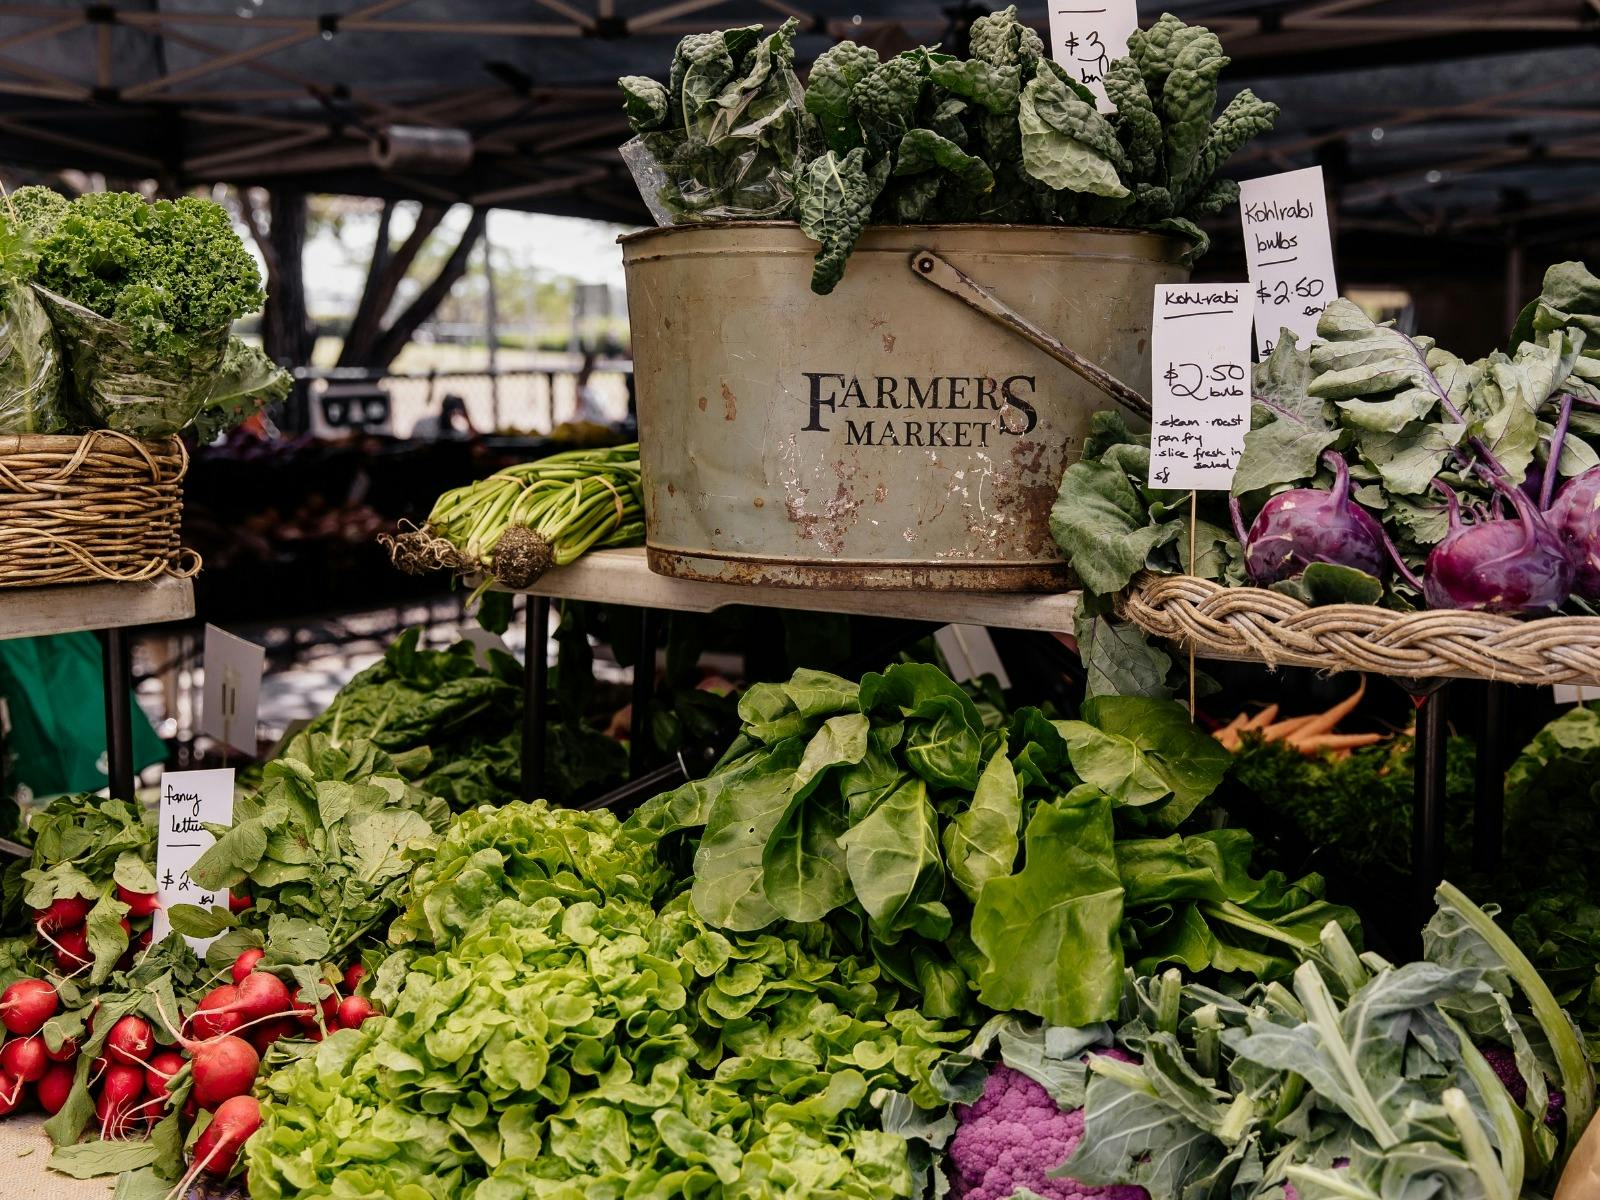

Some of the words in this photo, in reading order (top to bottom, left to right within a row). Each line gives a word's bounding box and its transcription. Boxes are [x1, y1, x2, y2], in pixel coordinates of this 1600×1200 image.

[1244, 198, 1314, 225] Kohlrabi
[1255, 231, 1298, 253] bulbs
[1256, 276, 1324, 305] $2.50
[1163, 361, 1245, 401] $2.50
[1210, 385, 1244, 397] bulb
[801, 372, 1038, 436] FARMERS
[844, 420, 992, 448] MARKET
